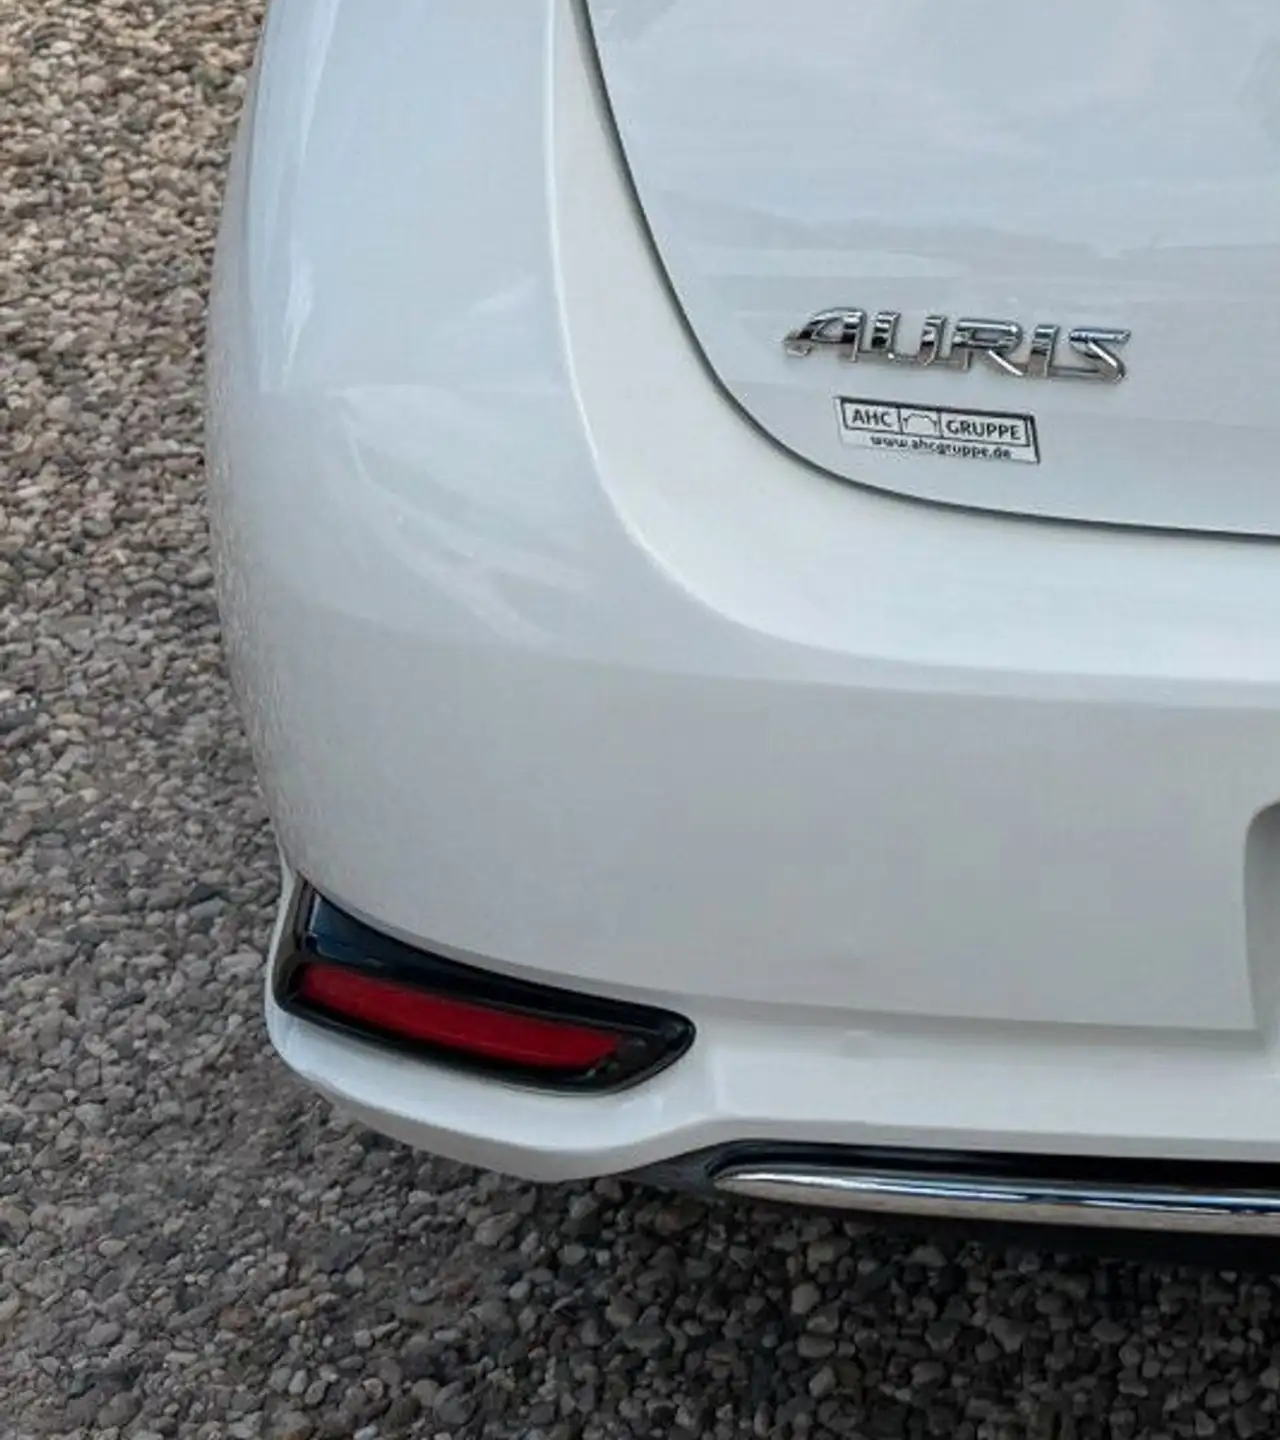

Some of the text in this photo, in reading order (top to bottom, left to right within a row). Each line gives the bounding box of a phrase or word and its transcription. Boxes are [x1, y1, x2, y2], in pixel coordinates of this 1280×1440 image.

[784, 307, 1131, 382] AURIS
[852, 408, 1021, 440] AHC GRUPPE
[869, 435, 1012, 459] www.ahcgruppe.de
